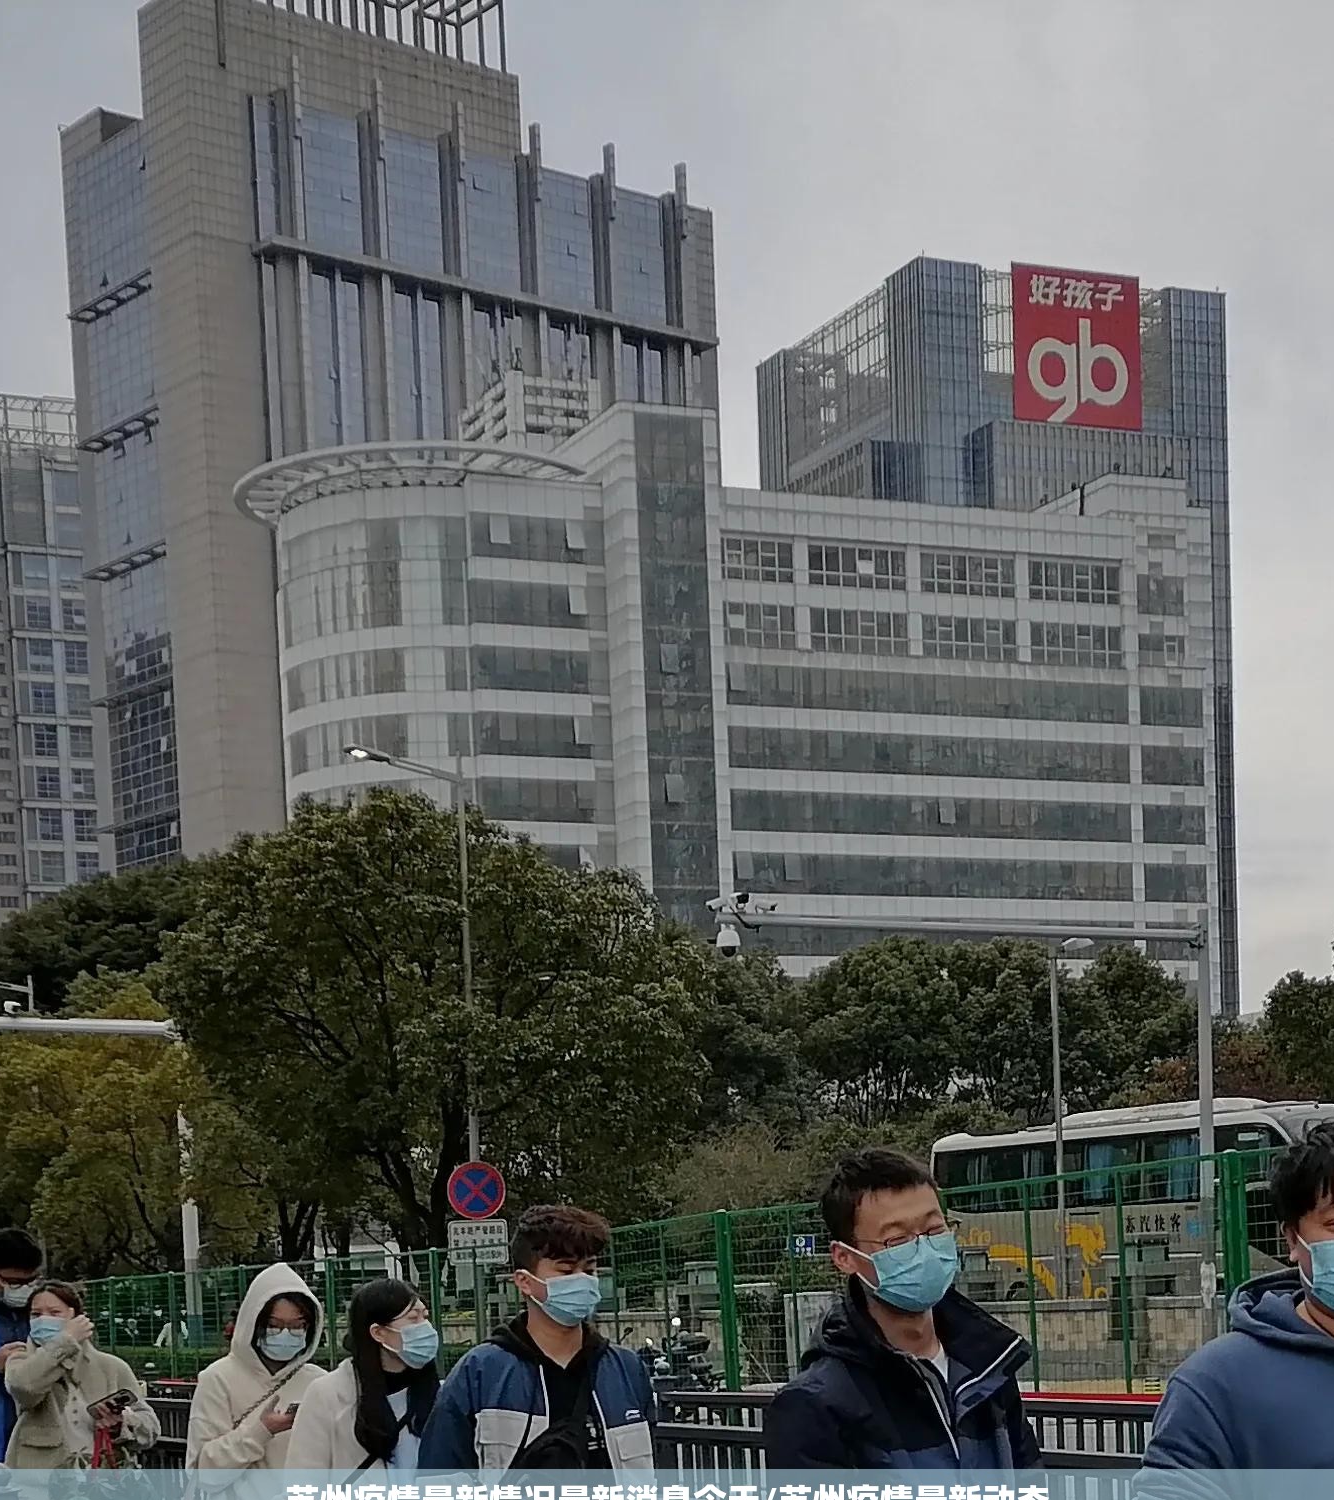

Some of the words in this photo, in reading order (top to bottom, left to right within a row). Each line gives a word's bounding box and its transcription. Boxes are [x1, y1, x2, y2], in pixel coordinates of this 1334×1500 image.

[1028, 274, 1124, 312] 好孩子
[1027, 317, 1129, 423] gb
